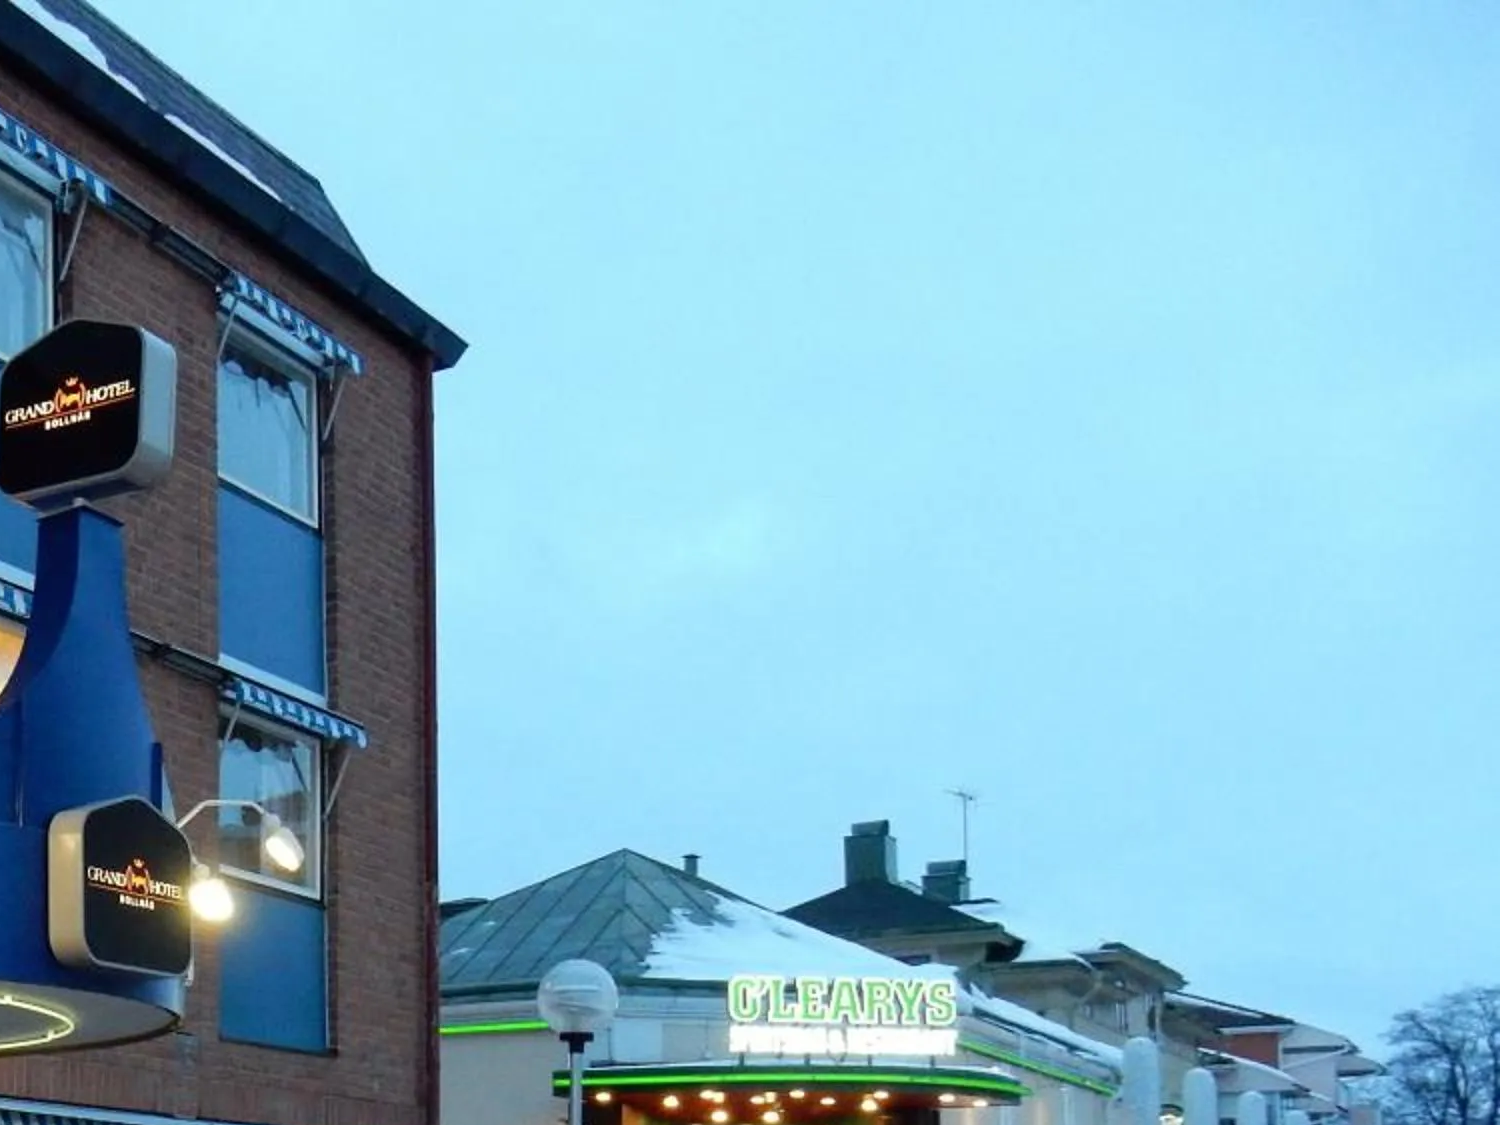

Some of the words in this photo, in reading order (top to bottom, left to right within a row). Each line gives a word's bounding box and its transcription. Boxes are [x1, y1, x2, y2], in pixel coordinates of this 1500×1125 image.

[5, 400, 55, 424] GRAND
[86, 379, 136, 405] HOTEL
[87, 865, 126, 888] GRAND
[728, 973, 956, 1026] O'LEARYS
